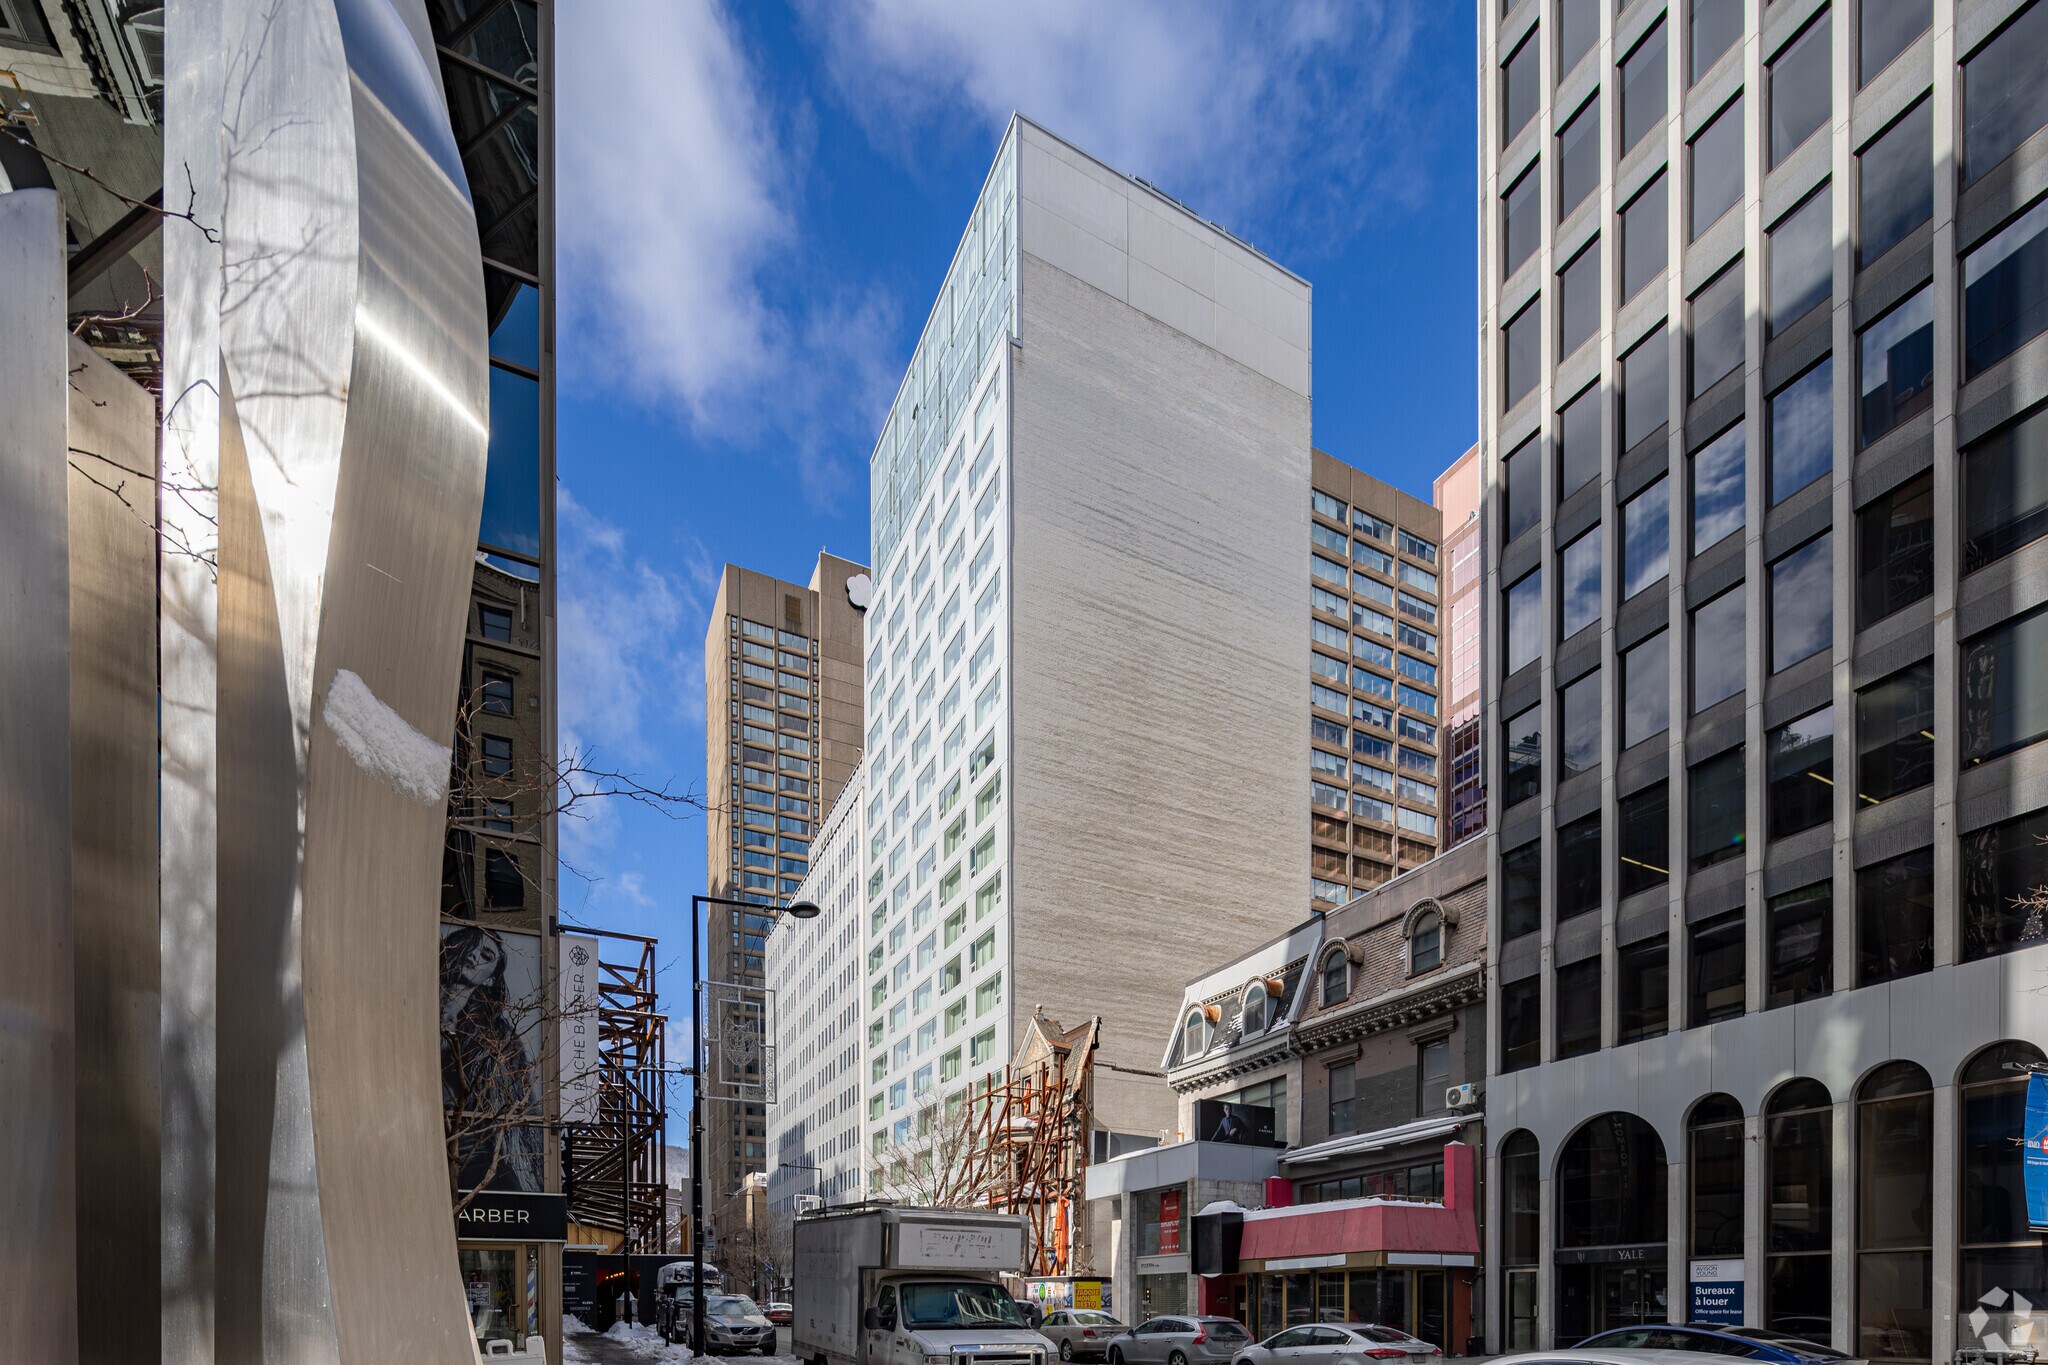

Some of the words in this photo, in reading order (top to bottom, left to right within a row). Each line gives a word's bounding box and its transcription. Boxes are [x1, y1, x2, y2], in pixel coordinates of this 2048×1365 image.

[574, 973, 585, 1034] BARBER
[574, 1040, 585, 1090] RUCHE
[575, 1097, 586, 1113] LA
[2027, 1140, 2040, 1148] BMO
[458, 1208, 530, 1224] ARBER
[1618, 1249, 1645, 1260] YALE
[1695, 1286, 1735, 1295] Bureaux
[1695, 1297, 1701, 1305] à
[1703, 1297, 1728, 1305] louer
